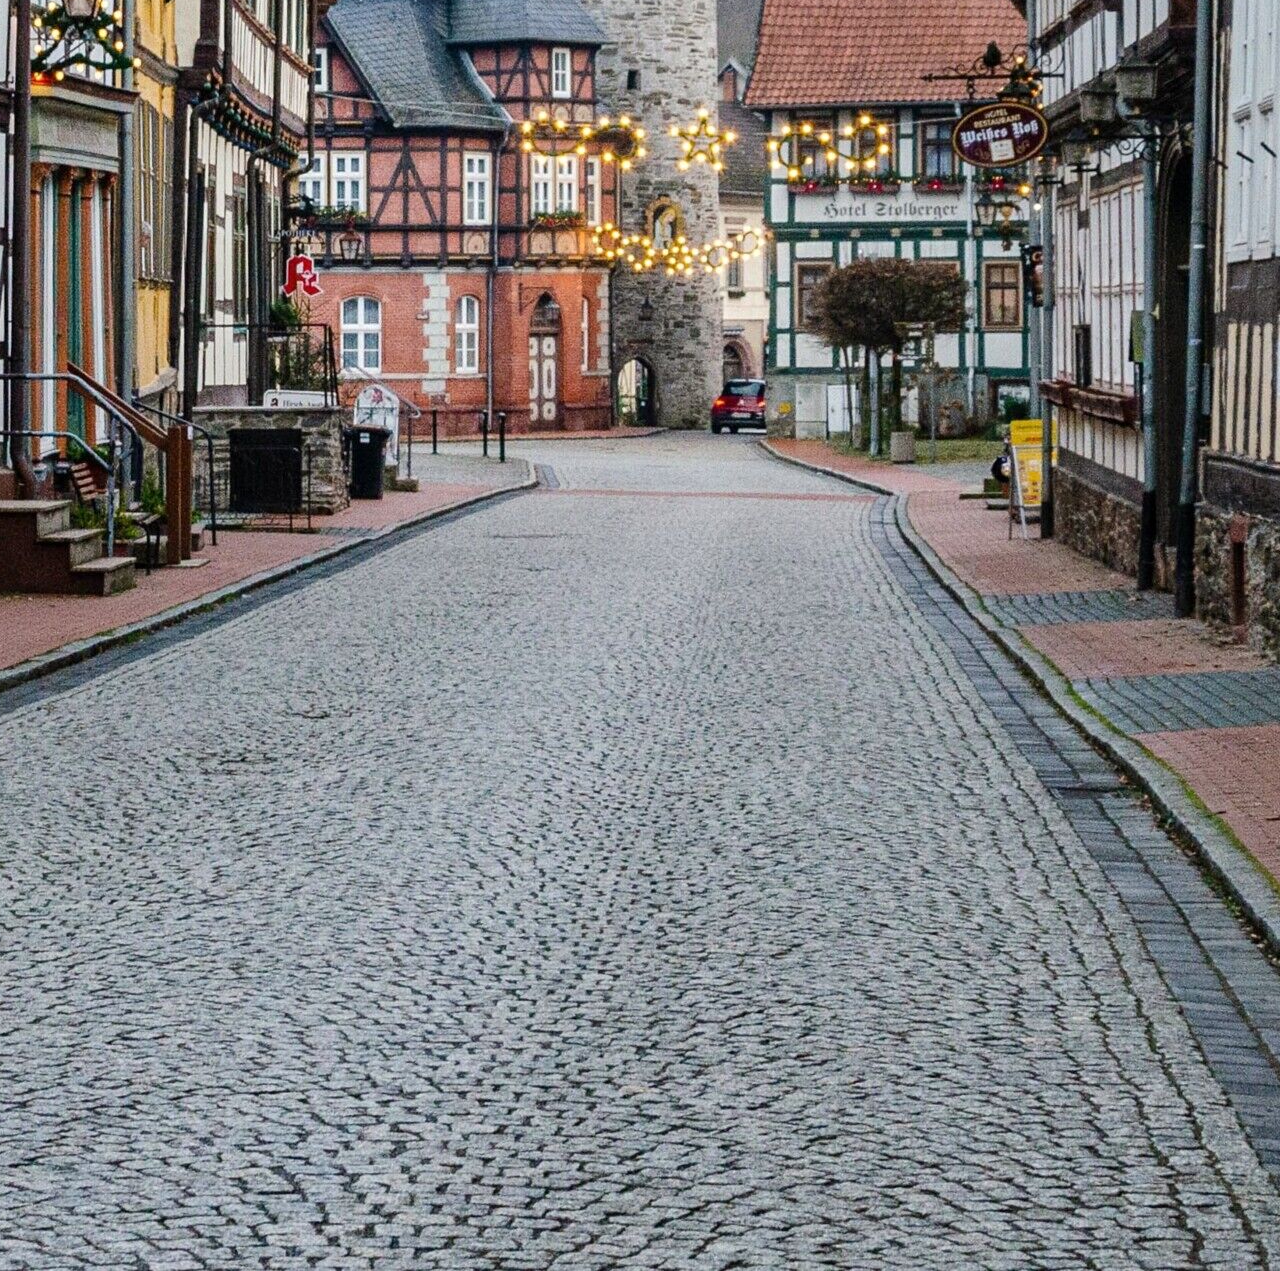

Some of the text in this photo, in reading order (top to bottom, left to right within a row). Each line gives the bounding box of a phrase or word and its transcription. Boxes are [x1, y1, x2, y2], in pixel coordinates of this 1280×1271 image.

[973, 114, 1022, 128] RESTAURANT
[984, 108, 1008, 119] HOTEL
[960, 119, 1039, 147] Weißes Roß
[823, 202, 959, 219] Hotel Stolberger
